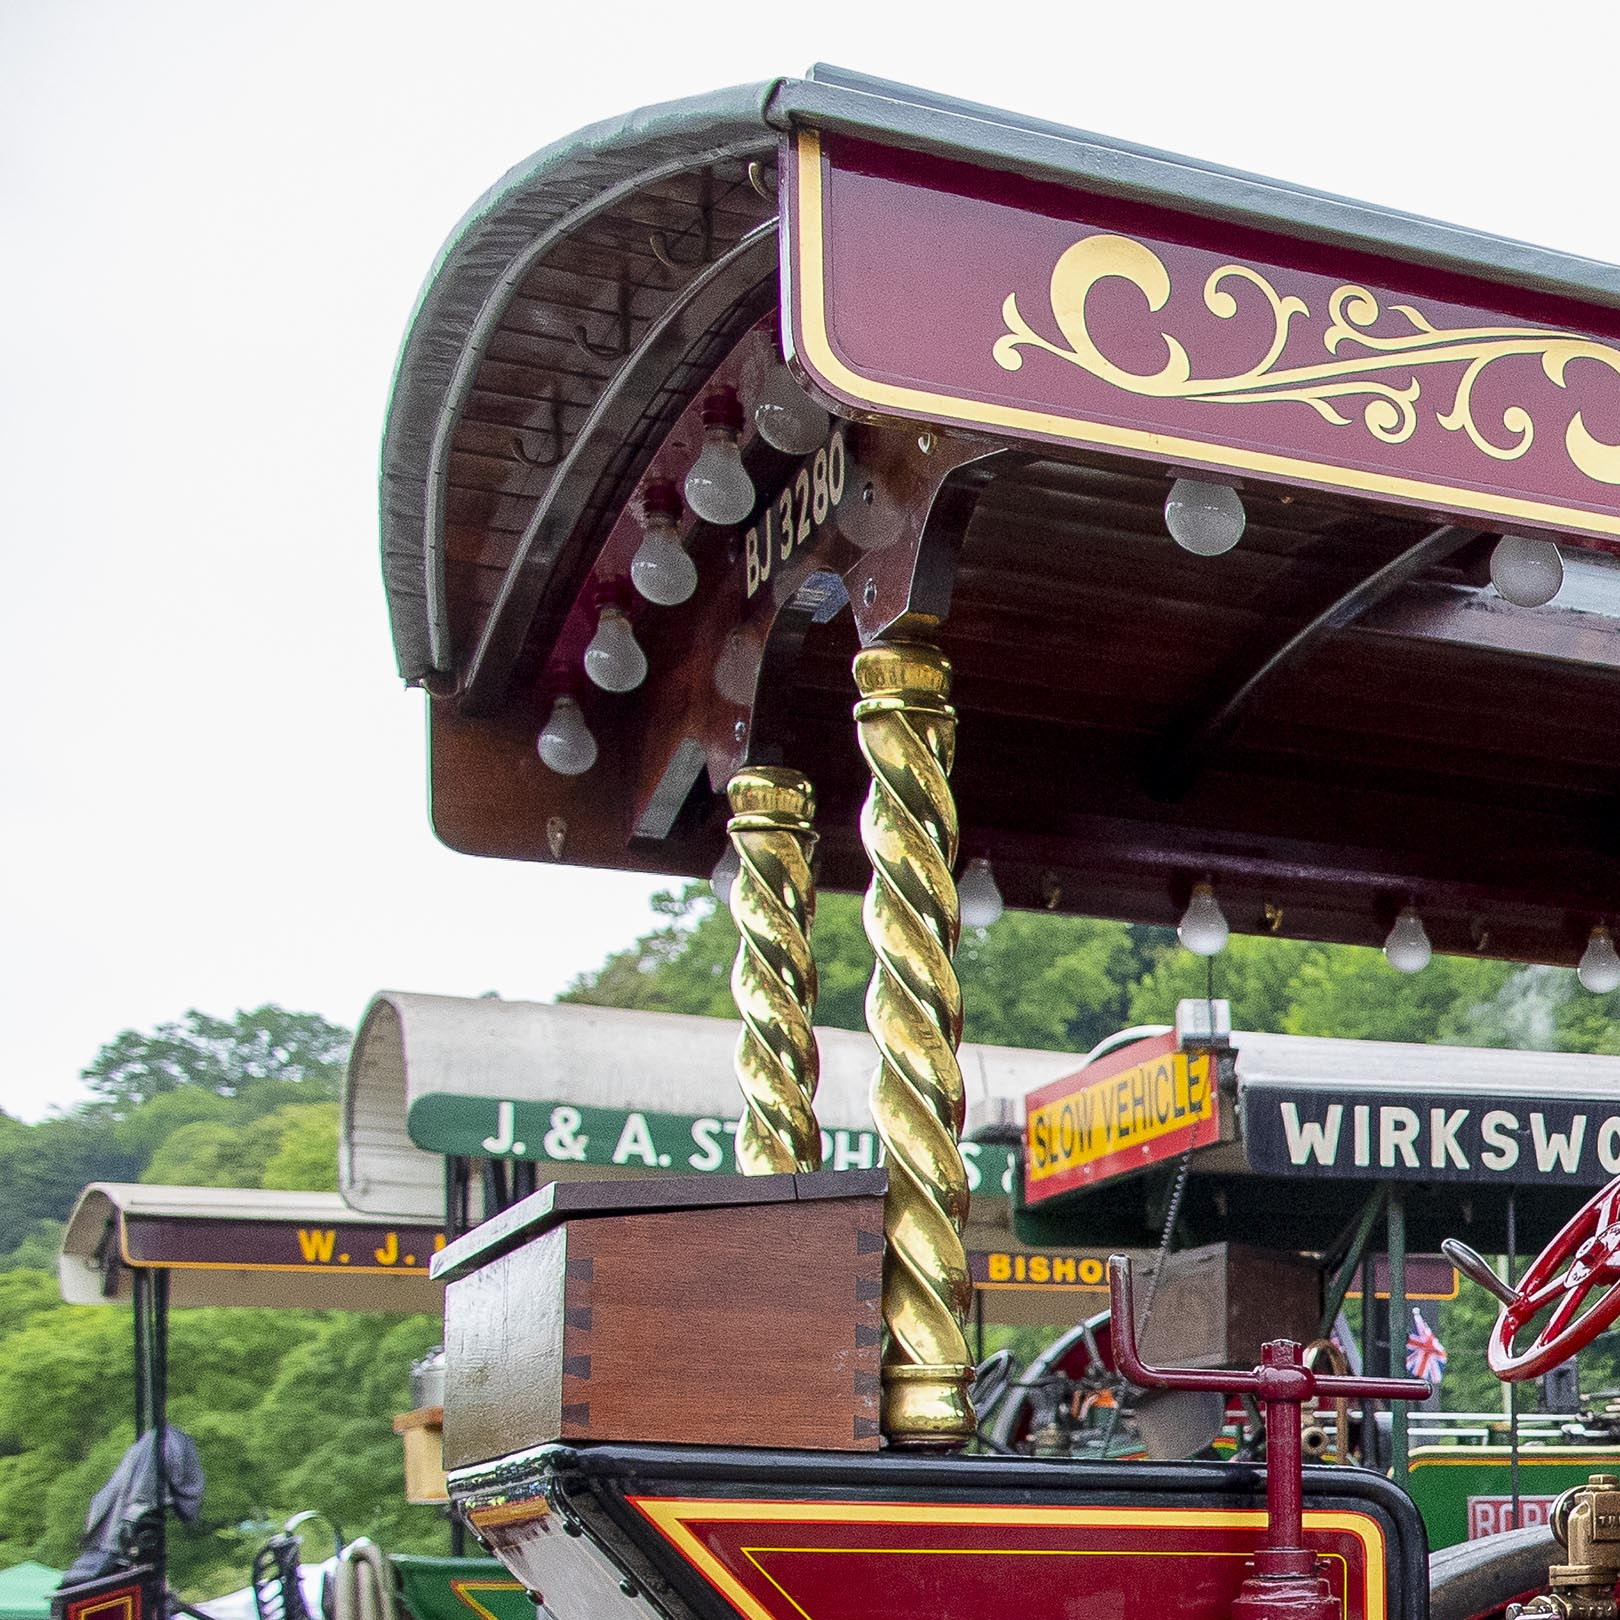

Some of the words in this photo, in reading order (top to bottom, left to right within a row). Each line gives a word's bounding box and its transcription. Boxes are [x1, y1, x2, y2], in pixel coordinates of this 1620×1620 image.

[745, 507, 772, 599] BJ
[779, 431, 845, 561] 3280
[481, 1101, 527, 1155] J.
[543, 1105, 590, 1161] &
[611, 1113, 673, 1167] A.
[1034, 1088, 1096, 1169] SLOW
[1100, 1054, 1203, 1143] VEHICLE
[297, 1228, 350, 1263] W.
[374, 1231, 416, 1266] J.
[988, 1252, 1112, 1284] BISHO
